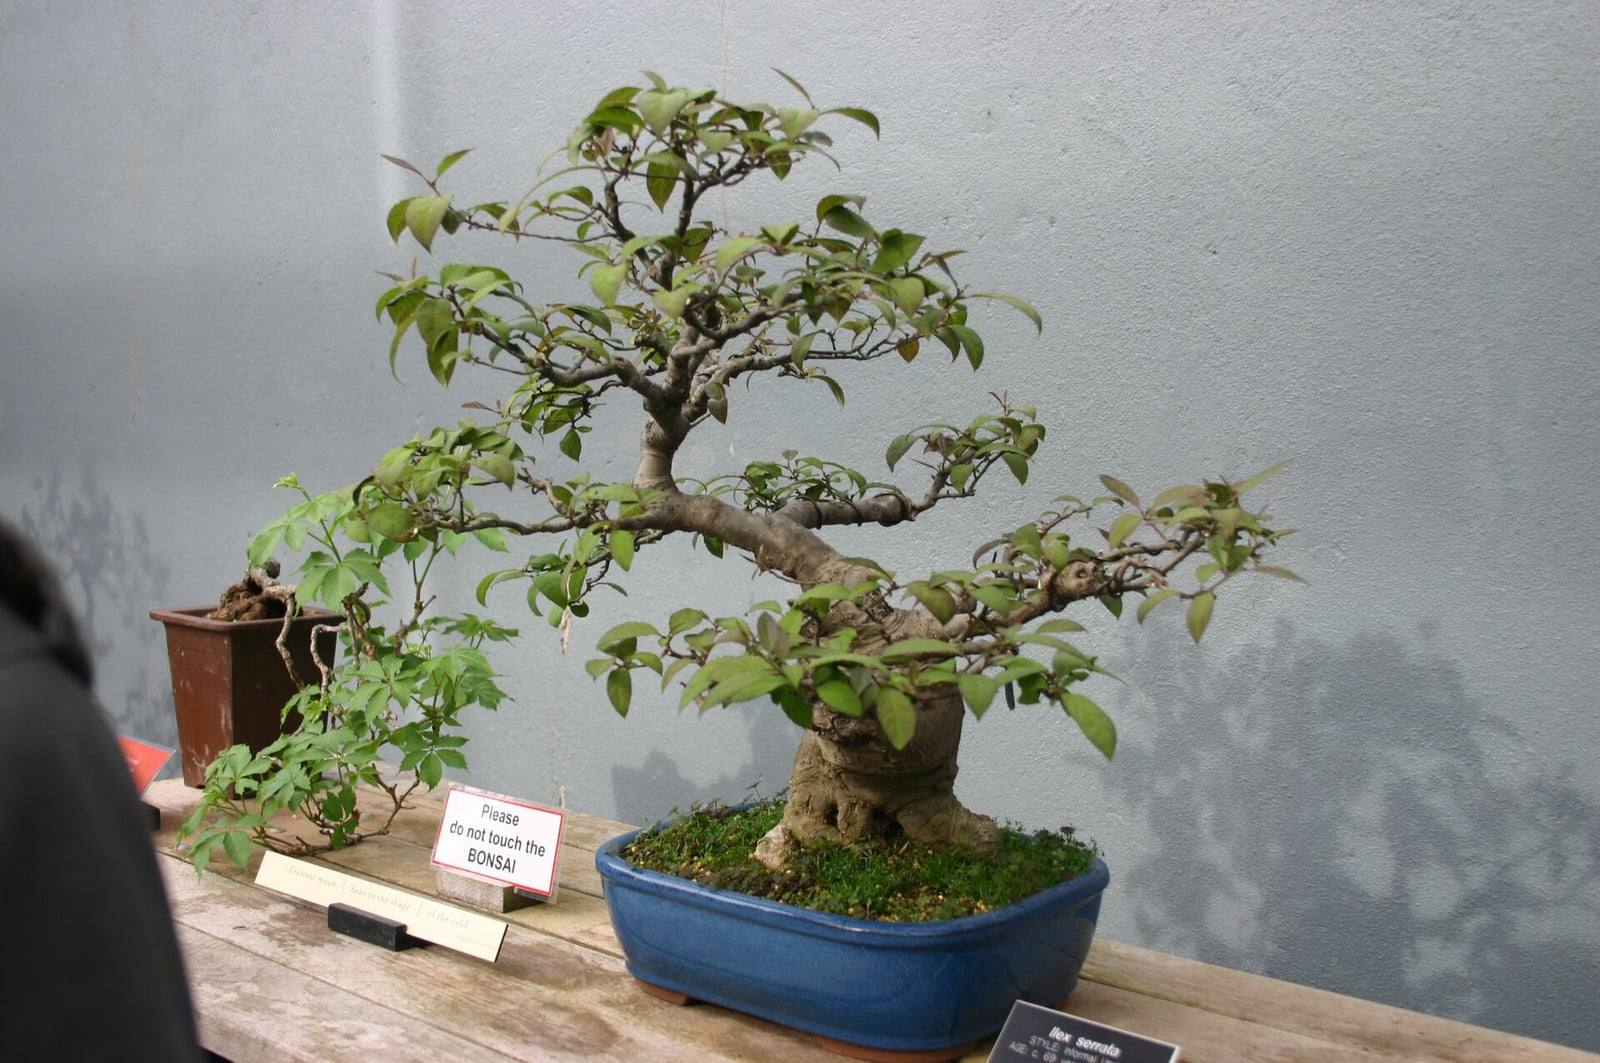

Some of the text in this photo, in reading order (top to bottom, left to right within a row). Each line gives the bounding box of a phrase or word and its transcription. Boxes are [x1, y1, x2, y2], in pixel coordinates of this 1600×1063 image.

[481, 804, 520, 826] Please
[449, 820, 546, 857] do not touch the
[467, 847, 517, 874] BONSAI
[377, 895, 389, 904] the
[1049, 1026, 1121, 1058] Ilex serrata
